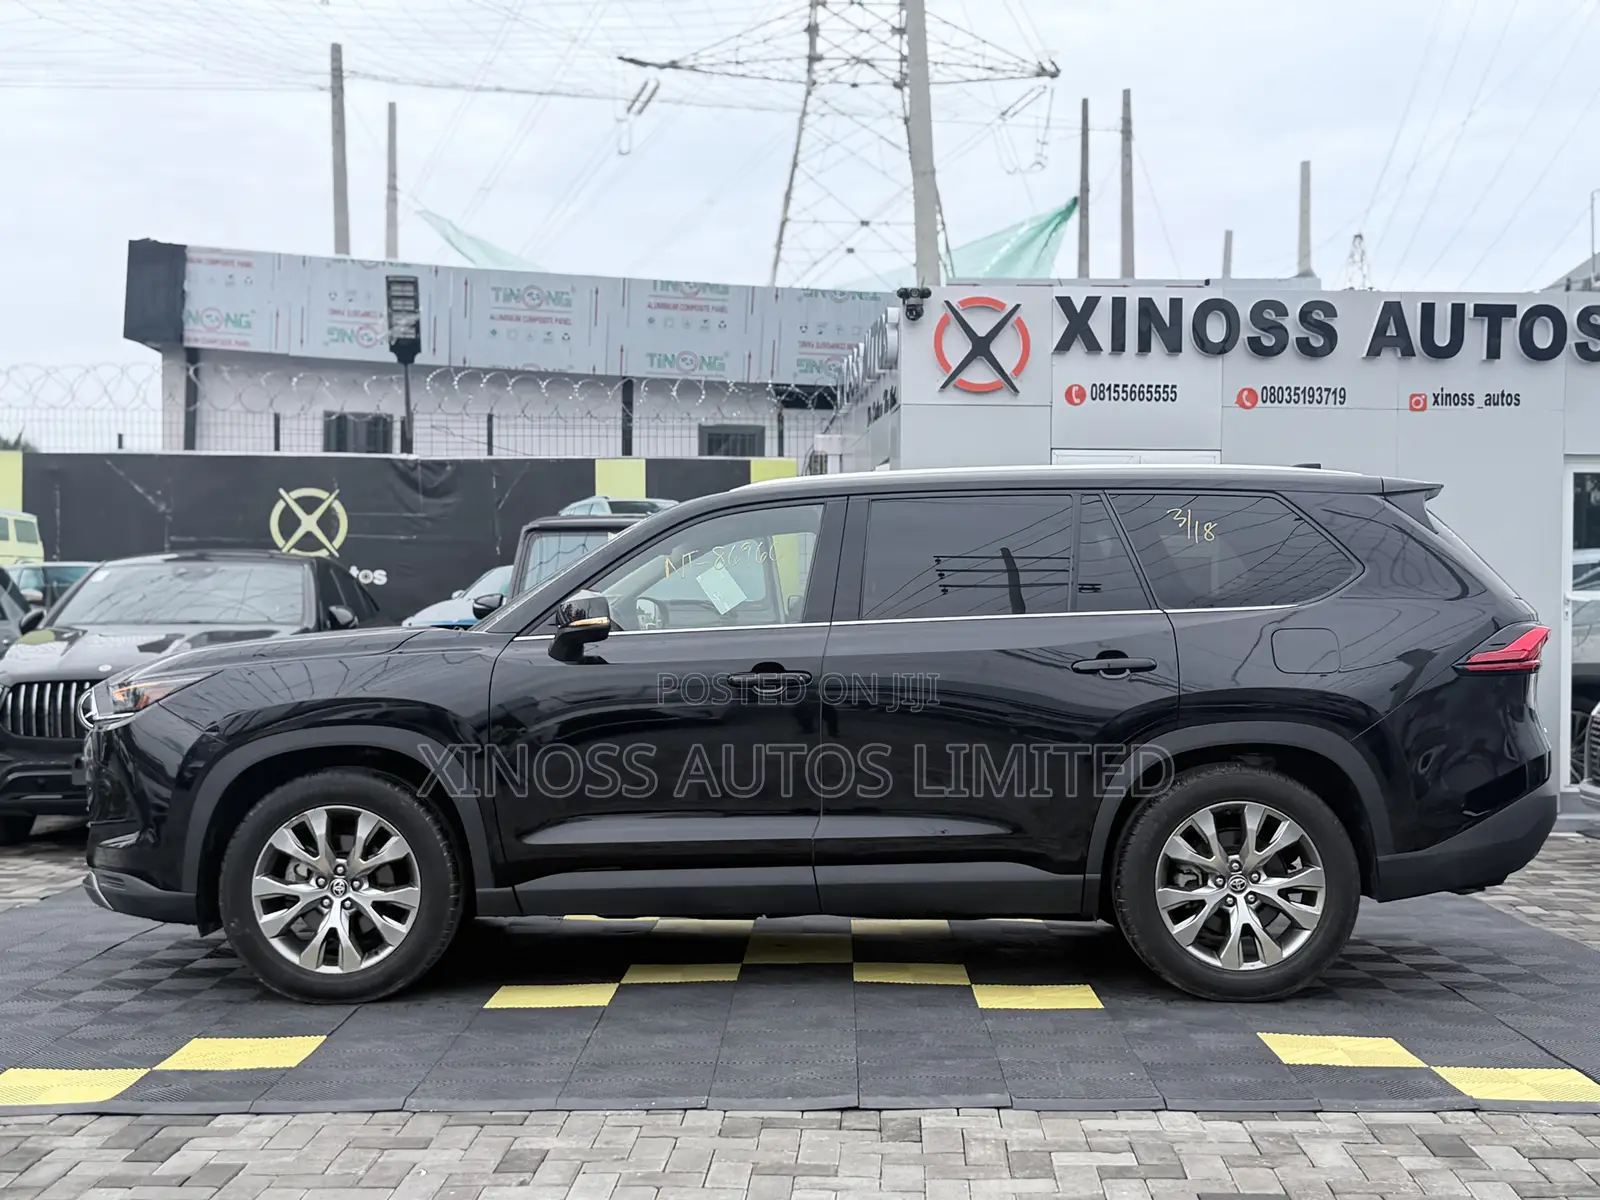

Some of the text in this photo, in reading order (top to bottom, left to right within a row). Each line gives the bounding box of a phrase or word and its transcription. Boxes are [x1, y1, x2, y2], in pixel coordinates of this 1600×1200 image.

[1052, 296, 1600, 361] XINOSS AUTOS
[1090, 383, 1178, 402] 08155665555
[1261, 385, 1347, 405] 08035193719
[1166, 508, 1218, 544] 3/18
